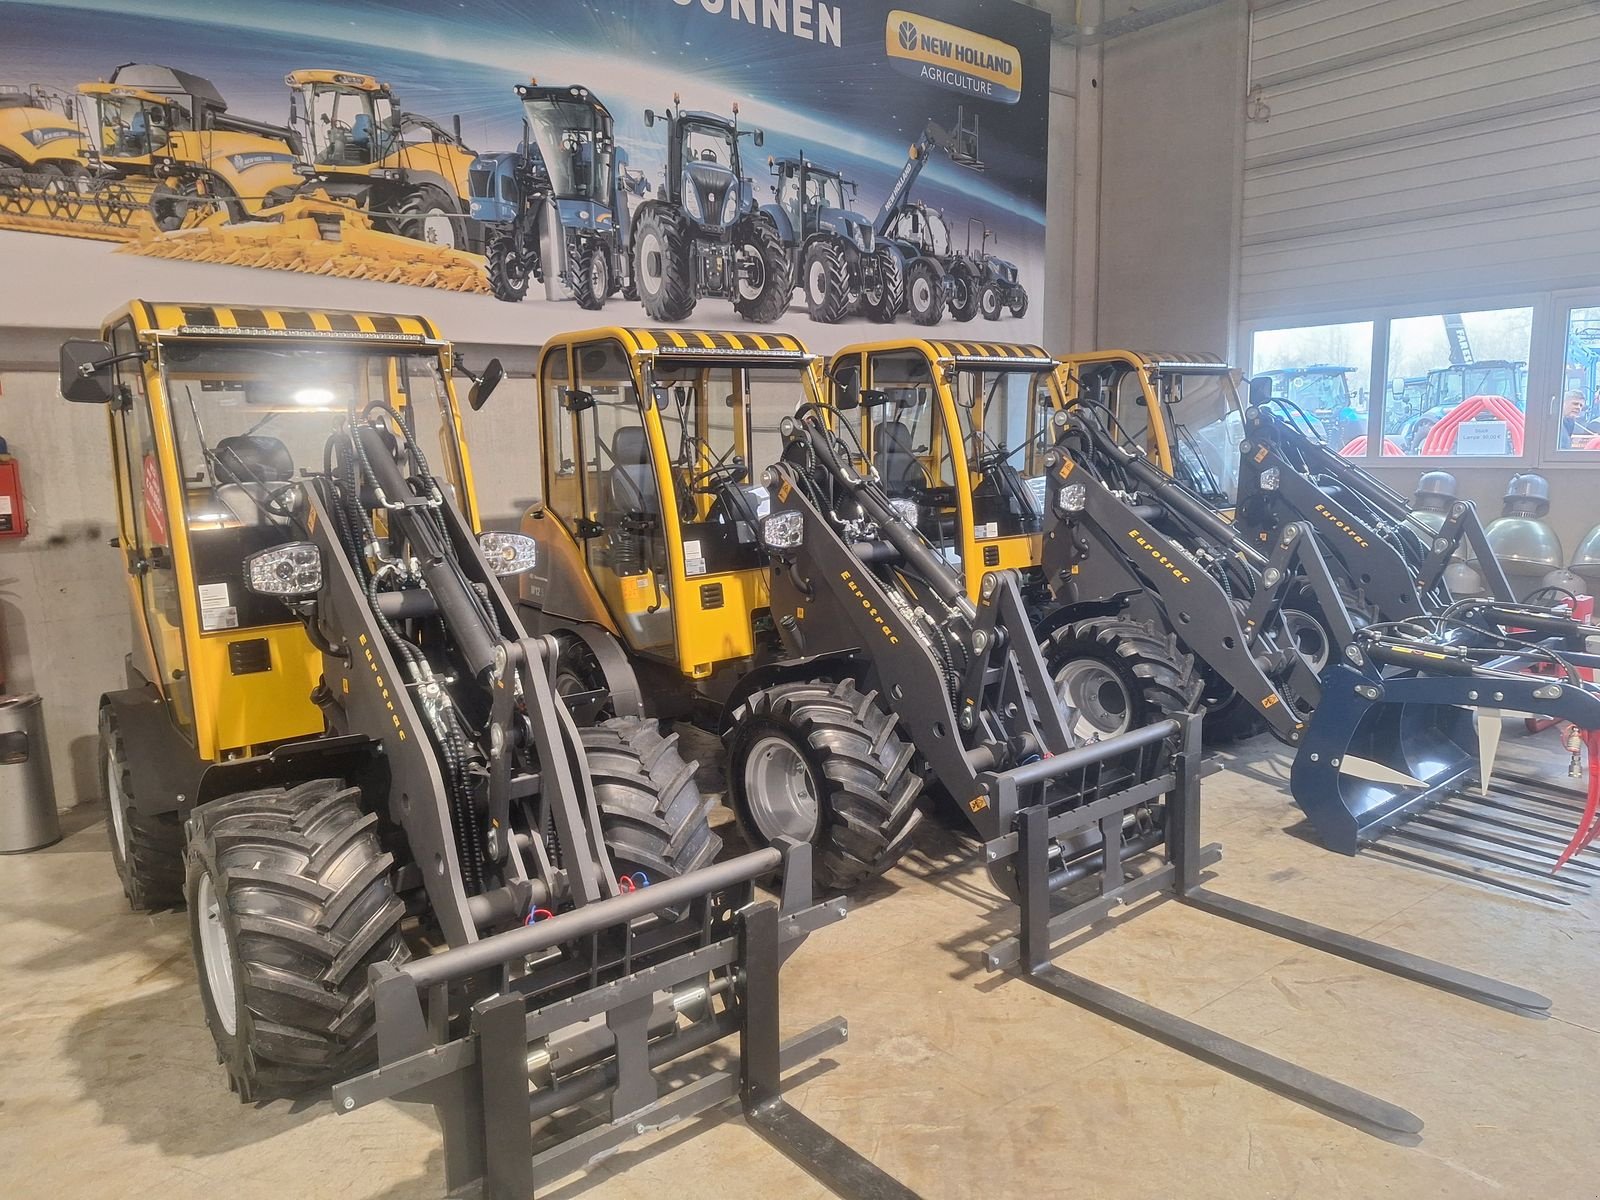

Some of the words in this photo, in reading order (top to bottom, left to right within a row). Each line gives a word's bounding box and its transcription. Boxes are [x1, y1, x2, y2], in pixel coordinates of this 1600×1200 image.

[920, 33, 952, 58] NEW
[955, 44, 1012, 76] HOLLAND
[920, 64, 992, 95] AGRICULTURE
[893, 162, 912, 196] HOLLAND
[1315, 504, 1369, 548] Eurotrac
[1128, 529, 1191, 584] Eurotrac
[840, 570, 899, 645] Eurotrac
[359, 633, 406, 741] Eurotrac
